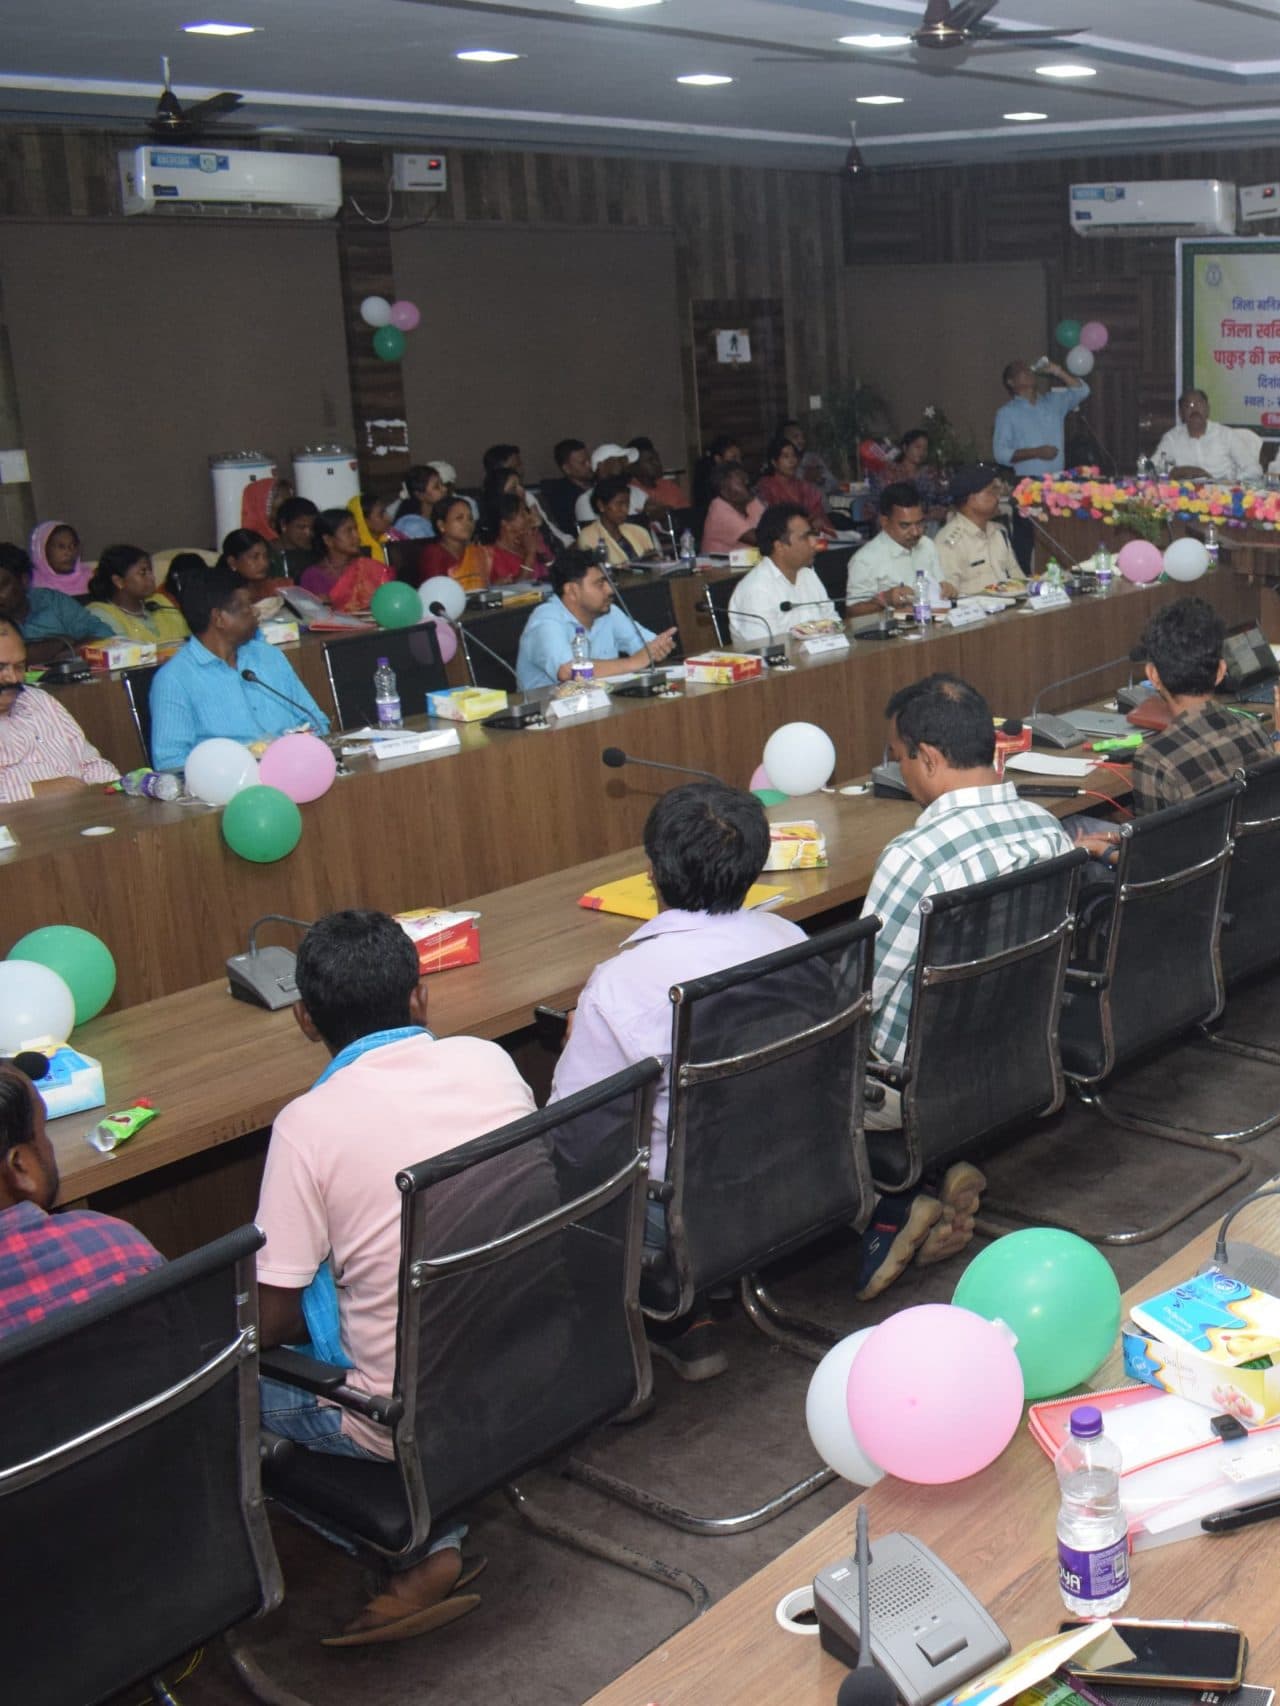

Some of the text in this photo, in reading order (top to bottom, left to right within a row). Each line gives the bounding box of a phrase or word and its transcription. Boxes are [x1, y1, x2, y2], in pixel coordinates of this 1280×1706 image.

[1232, 296, 1254, 312] जिला
[1221, 319, 1252, 338] जिला
[1213, 350, 1245, 370] पाकुड़
[1249, 346, 1265, 366] की
